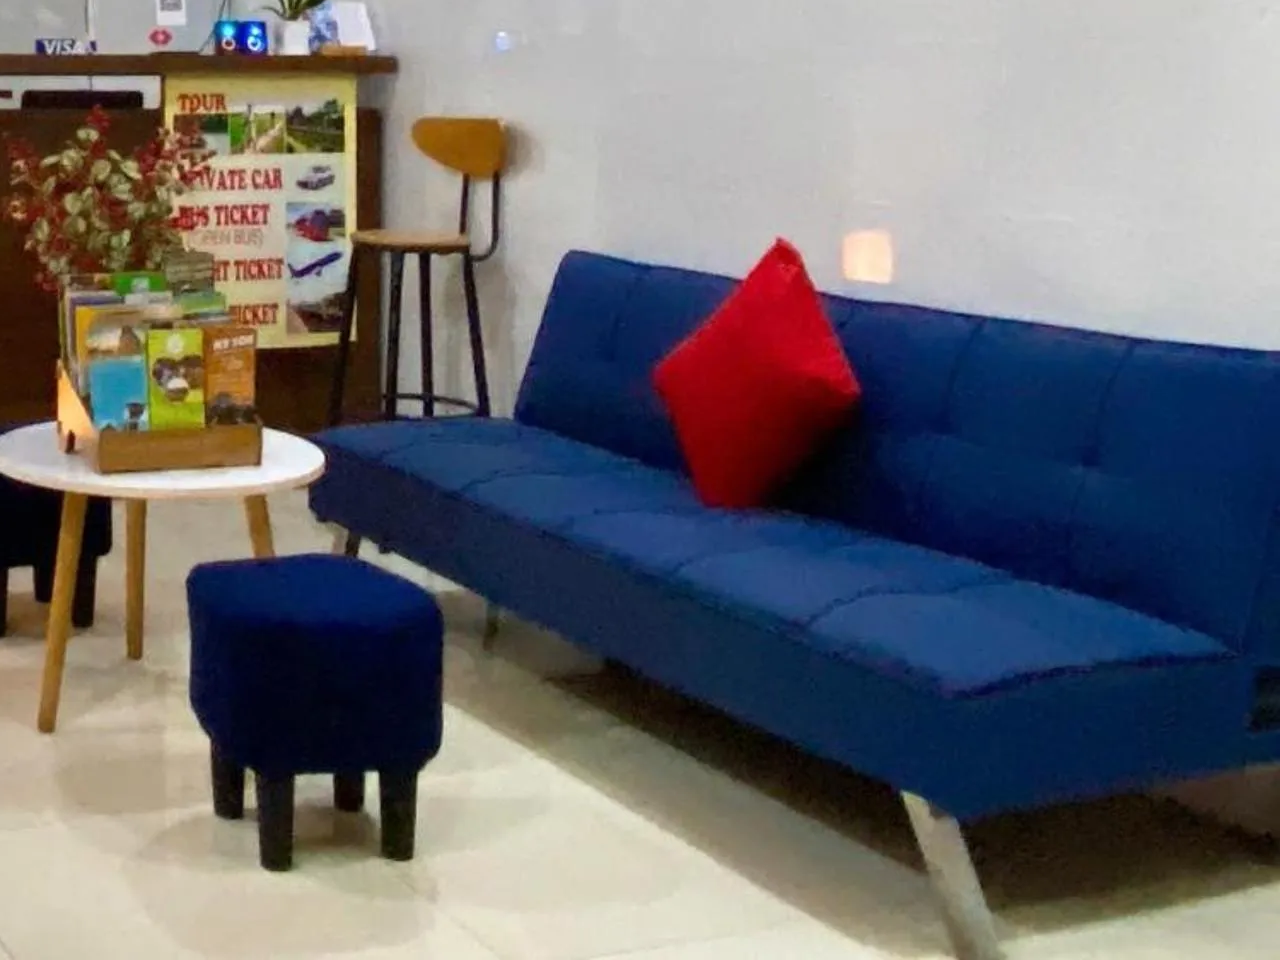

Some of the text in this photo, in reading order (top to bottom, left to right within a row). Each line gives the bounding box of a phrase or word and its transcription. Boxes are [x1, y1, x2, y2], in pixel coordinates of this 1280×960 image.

[43, 39, 87, 55] VISA
[177, 93, 228, 111] TOUR
[186, 167, 283, 191] VATE CAR
[214, 203, 270, 226] TICKET
[233, 257, 285, 282] TICKET
